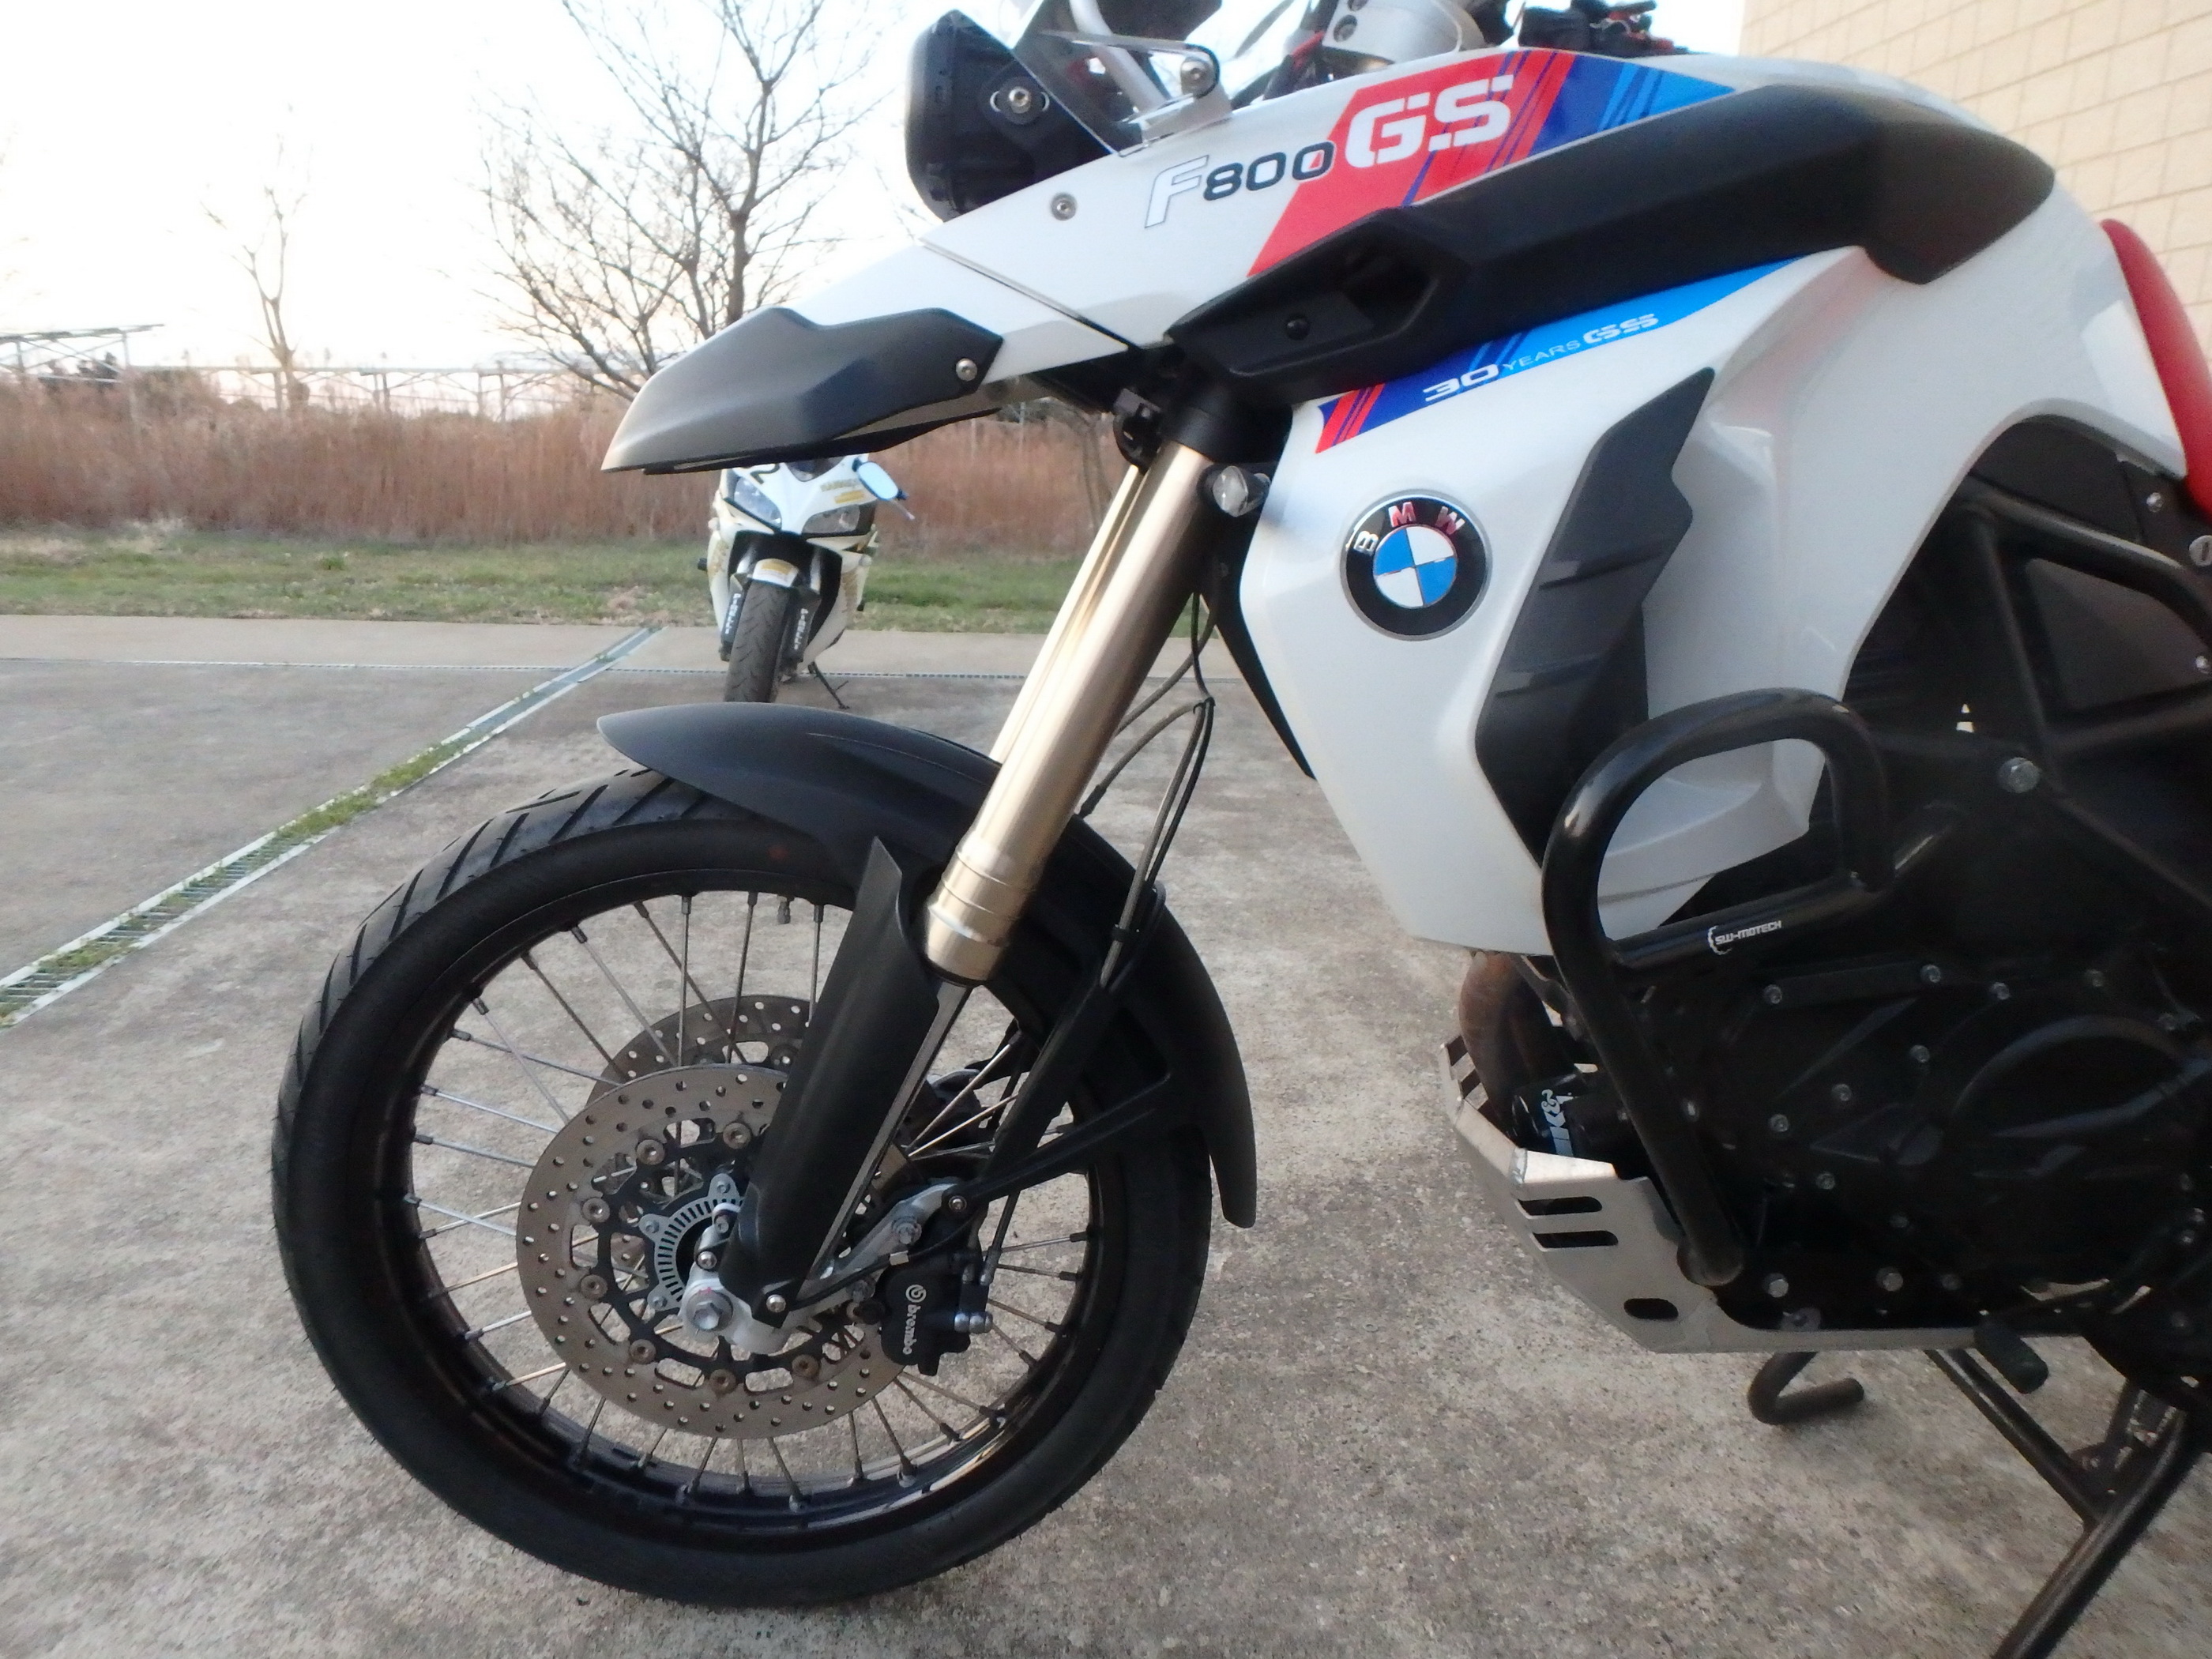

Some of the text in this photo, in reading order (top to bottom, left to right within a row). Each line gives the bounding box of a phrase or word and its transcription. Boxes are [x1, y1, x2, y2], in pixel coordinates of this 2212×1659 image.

[1345, 74, 1514, 169] GS
[1423, 313, 1659, 403] 30 YEARS GS
[1353, 501, 1465, 556] BMW
[1714, 920, 1782, 946] SW-MOTECH
[902, 1304, 921, 1355] brembo
